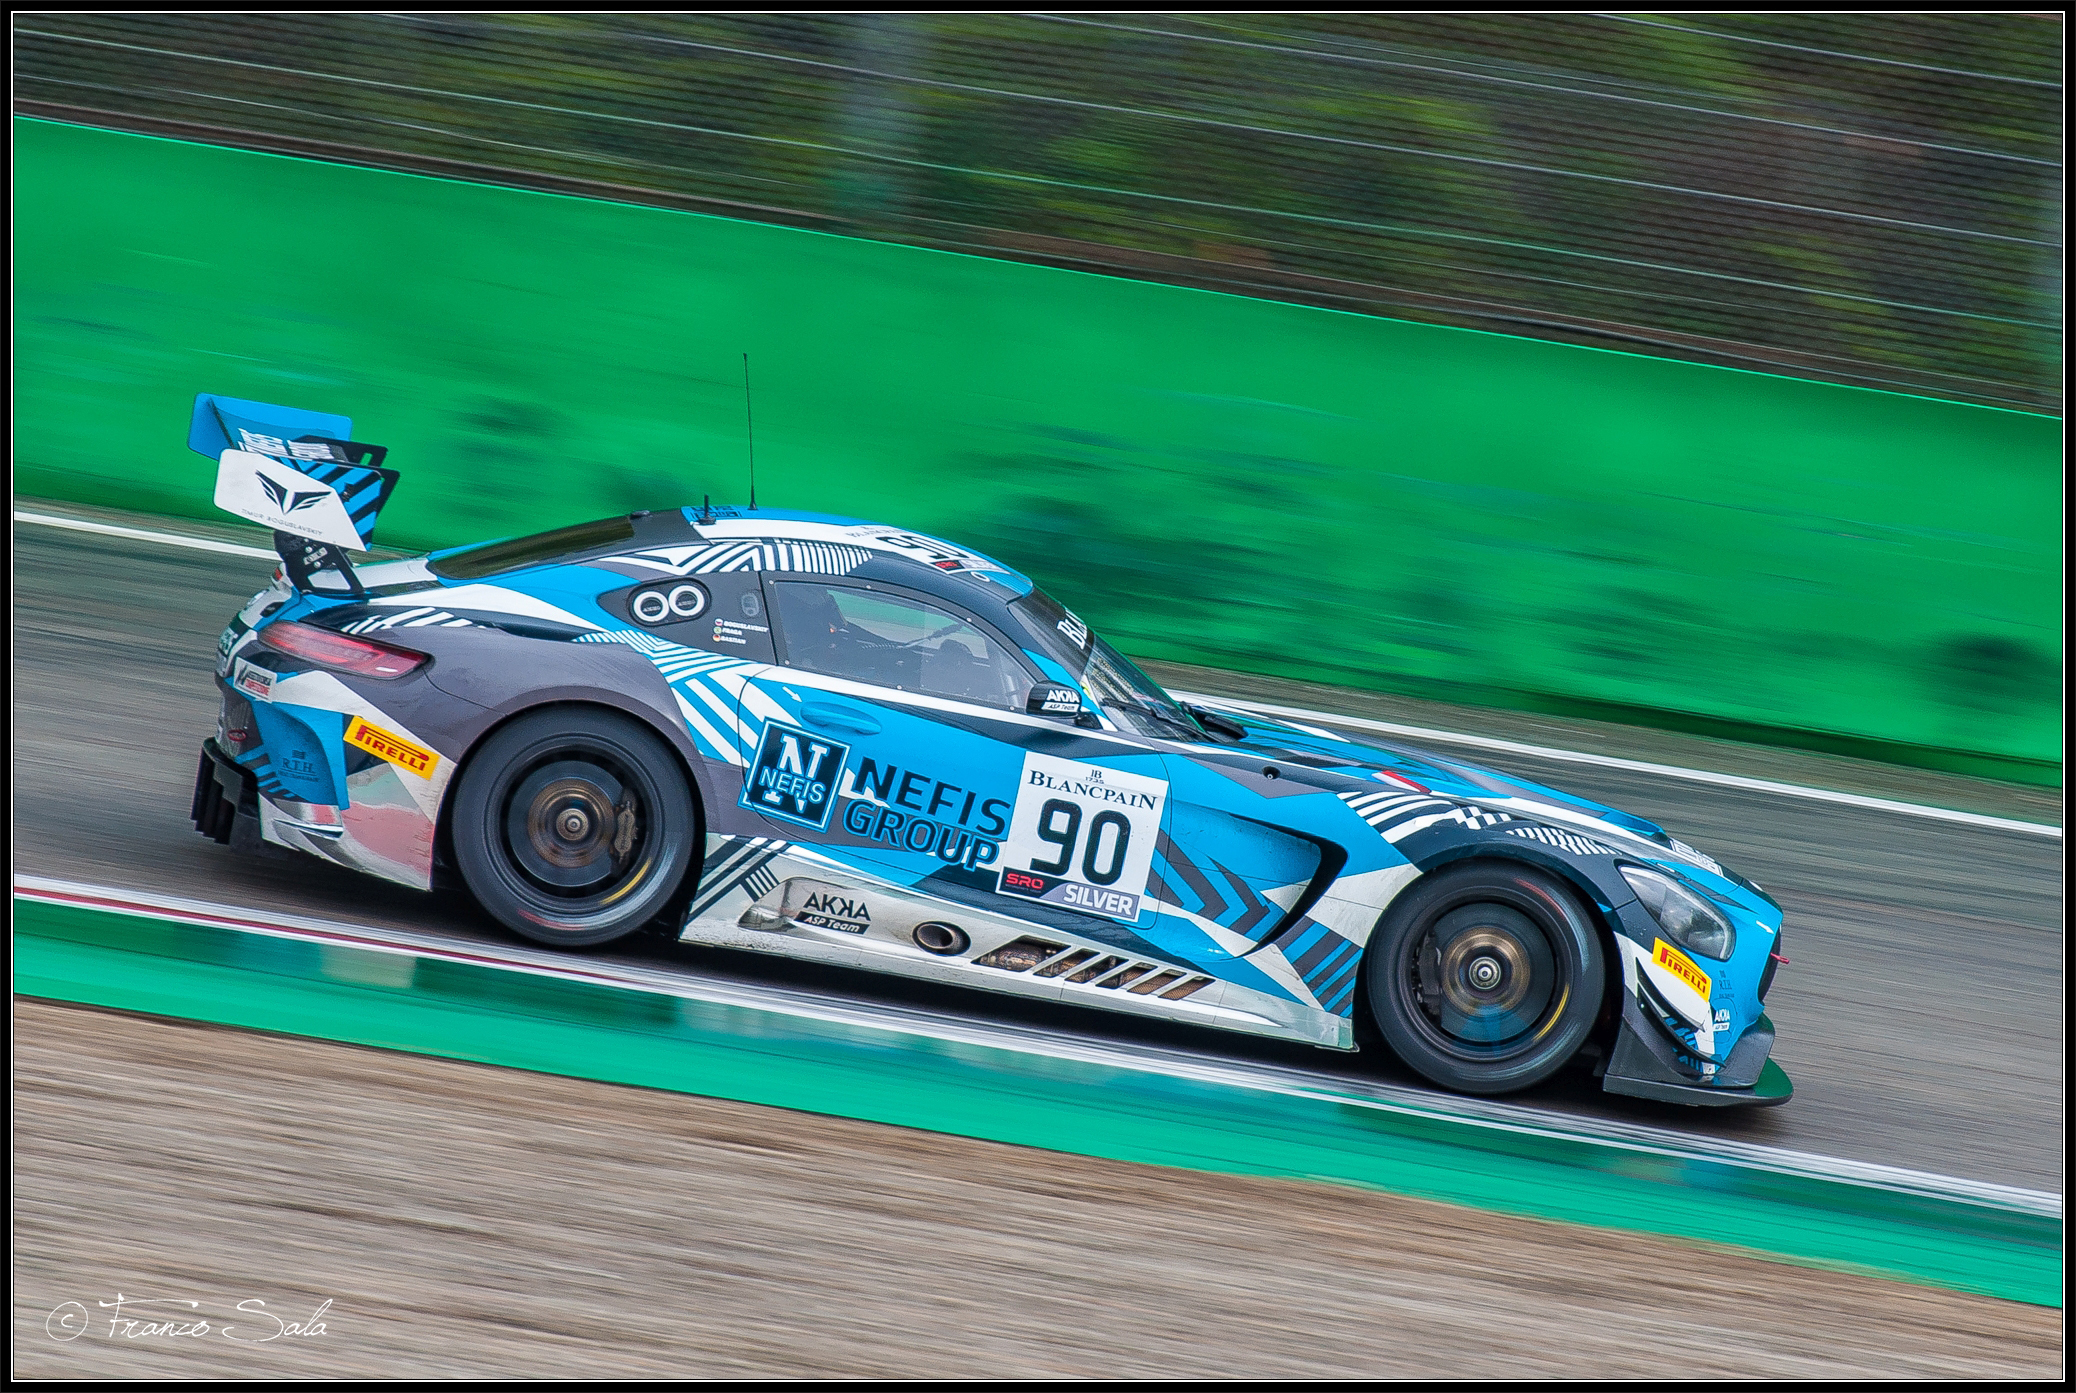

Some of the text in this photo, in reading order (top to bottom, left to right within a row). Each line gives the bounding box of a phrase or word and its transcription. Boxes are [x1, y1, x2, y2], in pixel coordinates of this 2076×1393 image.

[1046, 689, 1080, 703] AKKA
[354, 724, 430, 772] PIRELLI
[758, 766, 827, 805] NEFIS
[852, 757, 1011, 837] NEFIS
[843, 799, 1000, 873] GROUP
[1028, 798, 1132, 886] 90
[1005, 873, 1045, 889] SRO
[1063, 884, 1134, 916] SILVER
[803, 891, 872, 921] AKKA
[804, 915, 860, 933] ASP Team
[1659, 946, 1707, 995] PIRELLI
